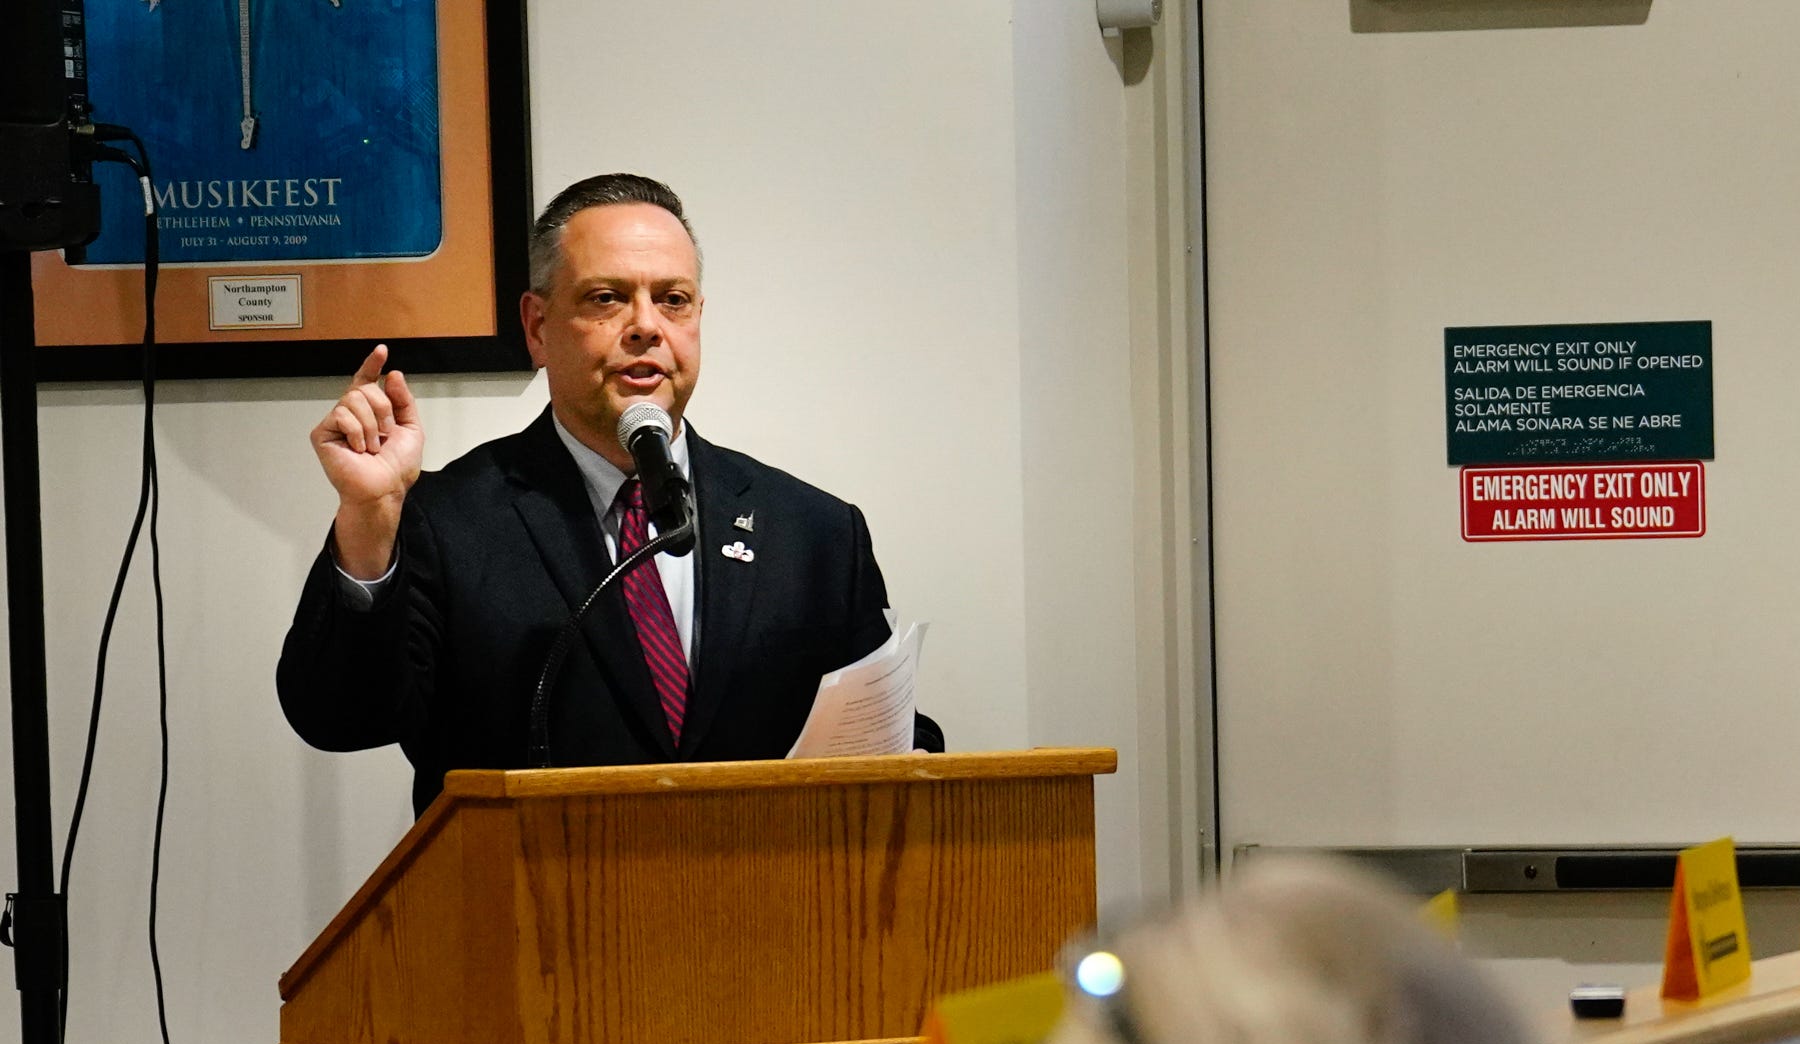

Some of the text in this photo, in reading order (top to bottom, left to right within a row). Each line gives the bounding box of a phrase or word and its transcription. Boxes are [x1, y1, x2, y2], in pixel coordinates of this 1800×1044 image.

[152, 178, 342, 209] MUSIKFEST
[157, 214, 341, 229] ETHLEHEM PENNSYLVANIA
[181, 237, 204, 248] JULY
[207, 237, 217, 246] 31
[227, 236, 269, 246] AUGUST
[273, 236, 281, 246] 9,
[284, 235, 308, 245] 2009
[224, 284, 287, 296] Northampton
[238, 298, 273, 308] County
[238, 314, 274, 322] SPONSOR
[1453, 341, 1637, 358] EMERGENCY EXIT ONLY
[1453, 355, 1703, 373] ALARM WILL SOUND IF OPENED
[1454, 384, 1646, 400] SALIDA DE EMERGENCIA
[1454, 402, 1551, 417] SOLAMENTE
[1455, 414, 1682, 432] ALAMA SONARA SE NE ABRE
[1472, 471, 1692, 501] EMERGENCY EXIT ONLY
[1492, 506, 1675, 531] ALARM WILL SOUND
